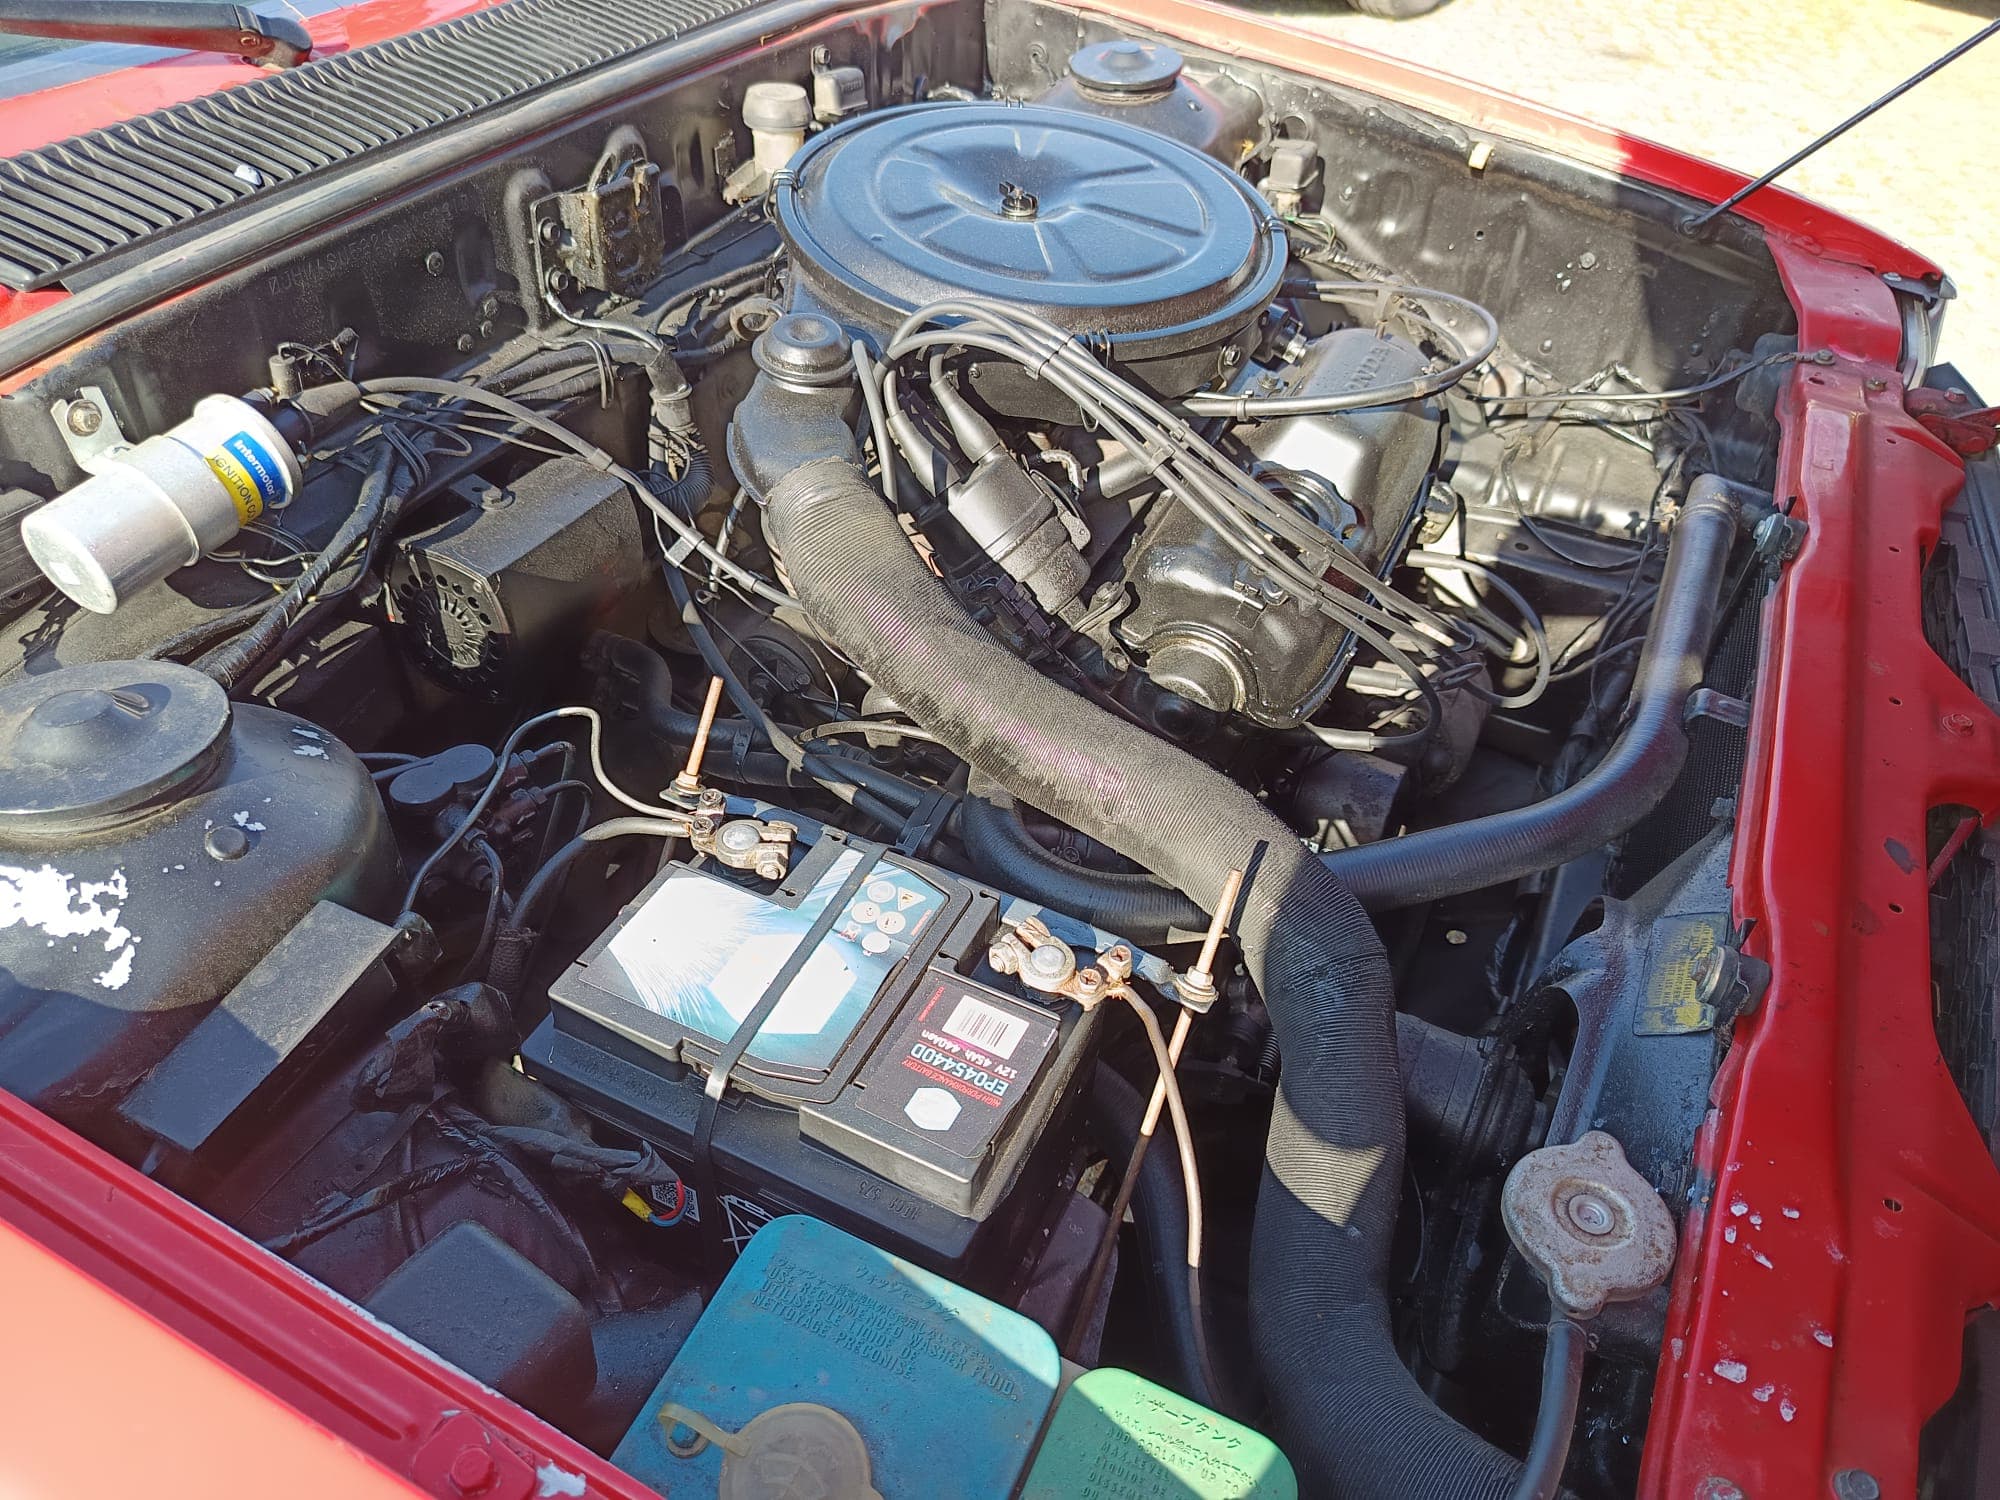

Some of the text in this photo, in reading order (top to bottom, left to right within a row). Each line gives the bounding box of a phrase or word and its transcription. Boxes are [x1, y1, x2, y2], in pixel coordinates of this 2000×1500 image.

[213, 454, 254, 505] IGNITION
[233, 439, 275, 496] Intermotor
[902, 1058, 934, 1080] BATTERY
[964, 1048, 993, 1068] 45Ah
[994, 1064, 1018, 1080] 12V
[932, 1071, 983, 1103] PERFORMANCE
[751, 1292, 831, 1338] NETTOYAGE
[759, 1279, 822, 1315] UTILISER
[825, 1308, 843, 1328] LE
[900, 1345, 920, 1363] DE
[768, 1265, 798, 1288] USE
[799, 1281, 905, 1340] RECOMMENDED
[909, 1333, 968, 1372] WASHER
